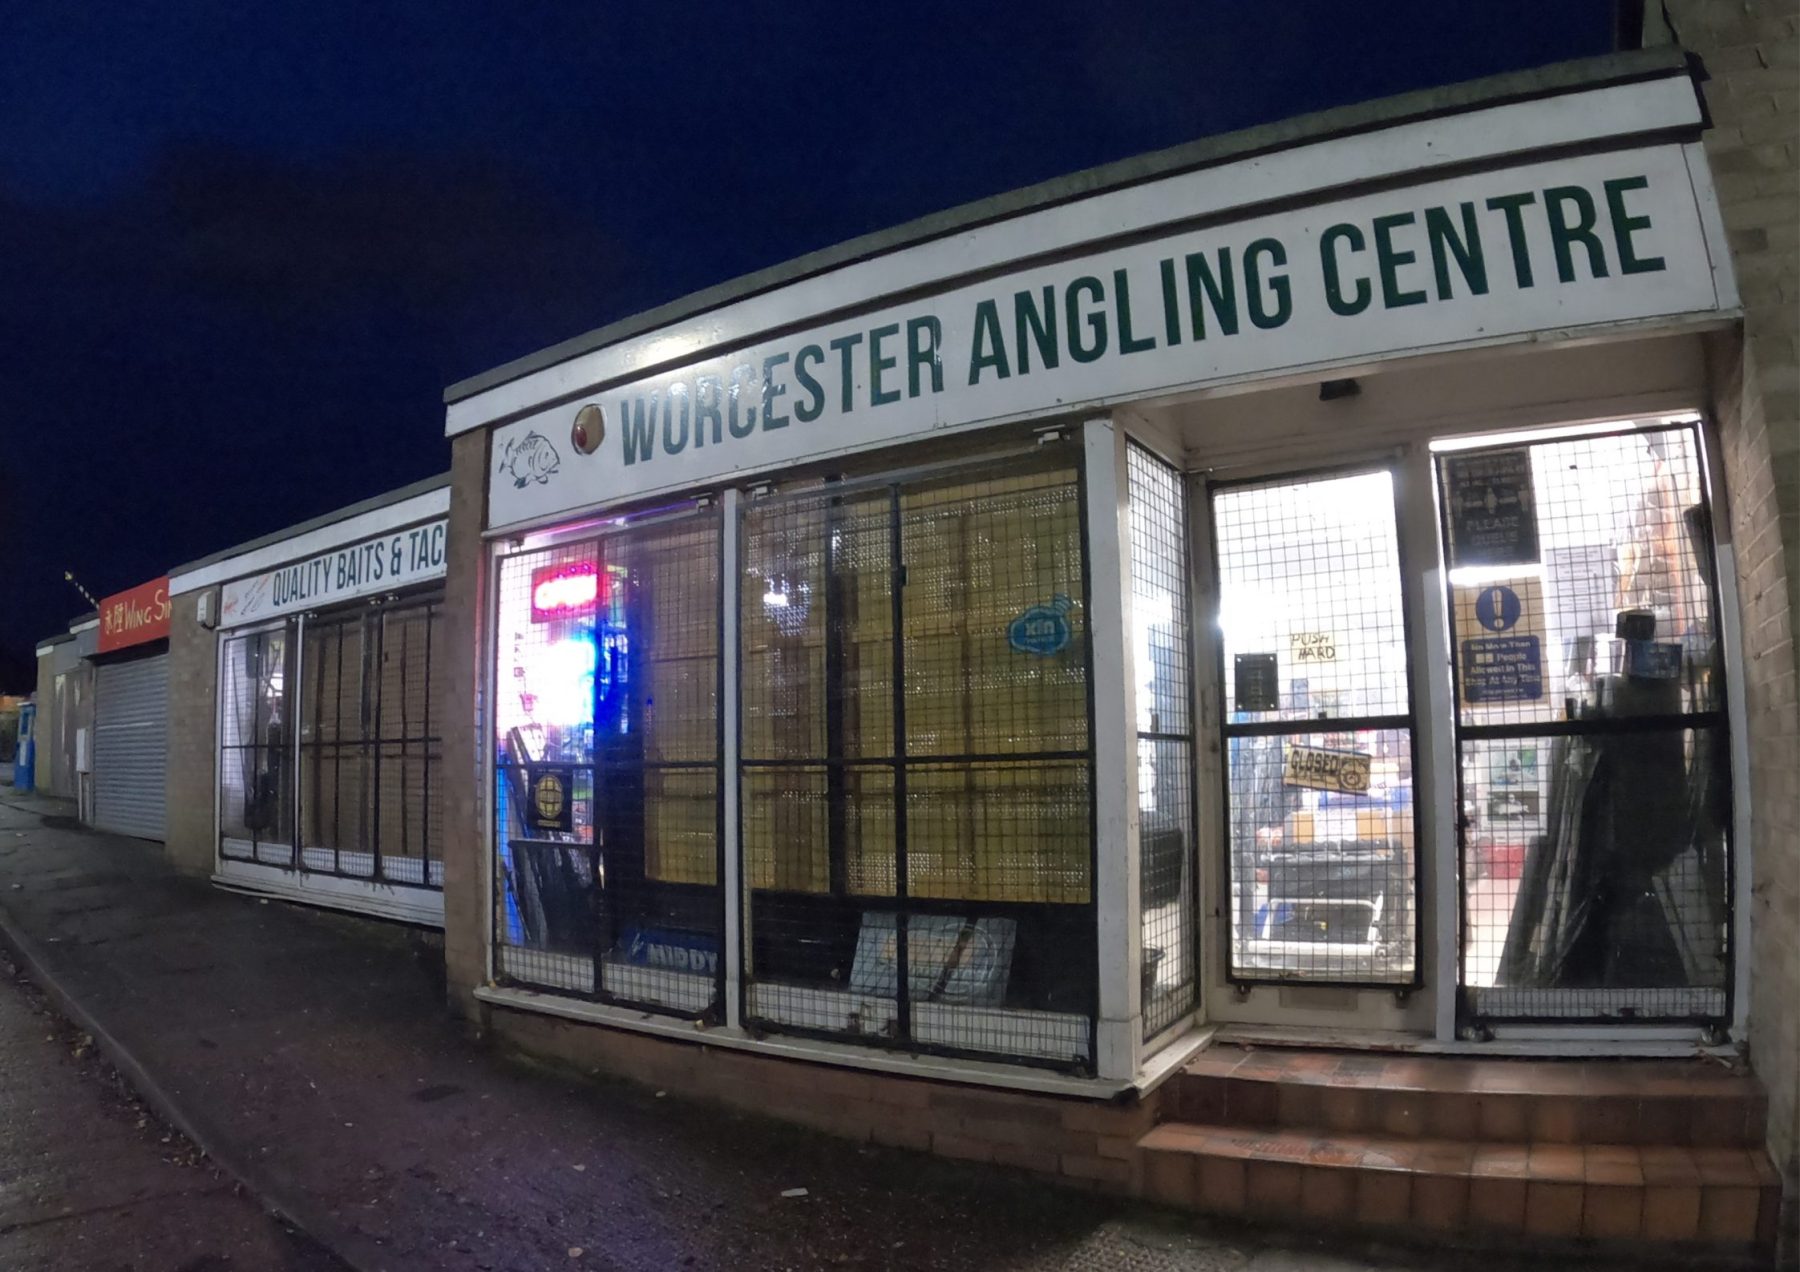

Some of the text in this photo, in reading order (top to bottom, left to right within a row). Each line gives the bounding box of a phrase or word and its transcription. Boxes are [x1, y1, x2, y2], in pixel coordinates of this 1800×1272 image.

[621, 174, 1667, 465] WORCESTER ANGLING CENTRE
[272, 524, 447, 607] QUALITY BAITS & TAC
[1291, 633, 1330, 646] PUSH
[1298, 646, 1336, 660] HARD
[1497, 653, 1528, 662] People
[1291, 750, 1340, 776] CLOSED
